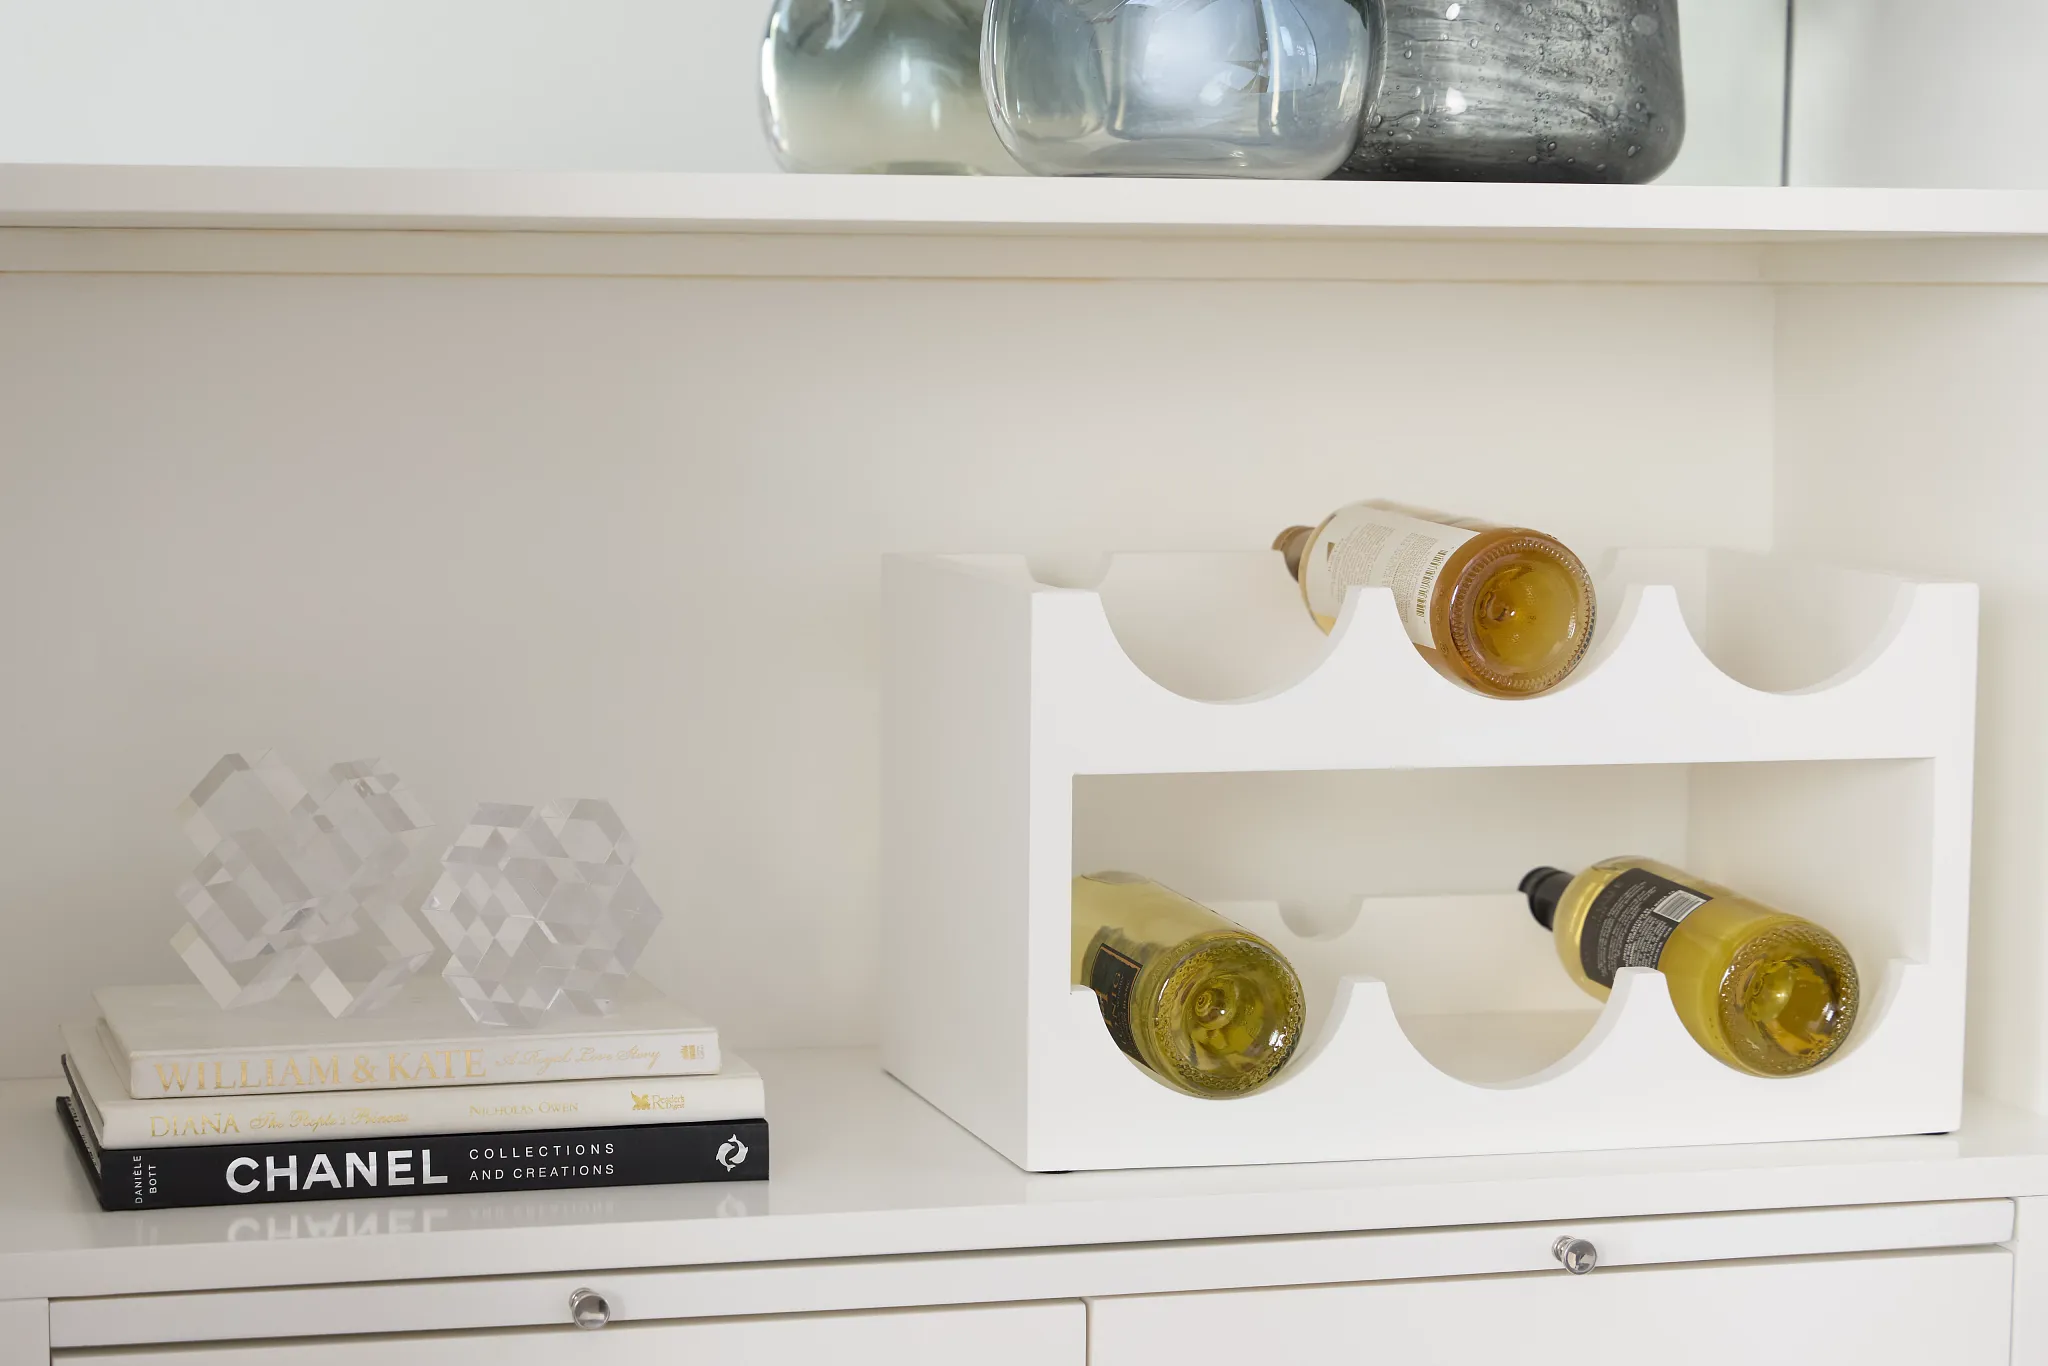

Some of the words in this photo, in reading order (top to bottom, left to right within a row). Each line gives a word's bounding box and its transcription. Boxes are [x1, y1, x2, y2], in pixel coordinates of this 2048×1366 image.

[154, 1055, 341, 1092] WILLIAM
[352, 1054, 379, 1083] &
[388, 1049, 487, 1081] KATE
[515, 1047, 572, 1075] Royal
[575, 1047, 613, 1064] Love
[617, 1045, 660, 1070] Story
[250, 1112, 285, 1130] The
[289, 1109, 347, 1132] People's
[351, 1107, 409, 1125] Princess
[538, 1100, 579, 1114] OWEN
[150, 1112, 240, 1137] DIANA
[469, 1142, 615, 1160] COLLECTIONS
[132, 1155, 143, 1203] DANIÈLE
[148, 1164, 157, 1193] BOTT
[225, 1148, 448, 1193] CHANEL
[469, 1167, 504, 1181] AND
[513, 1164, 615, 1180] CREATIONS
